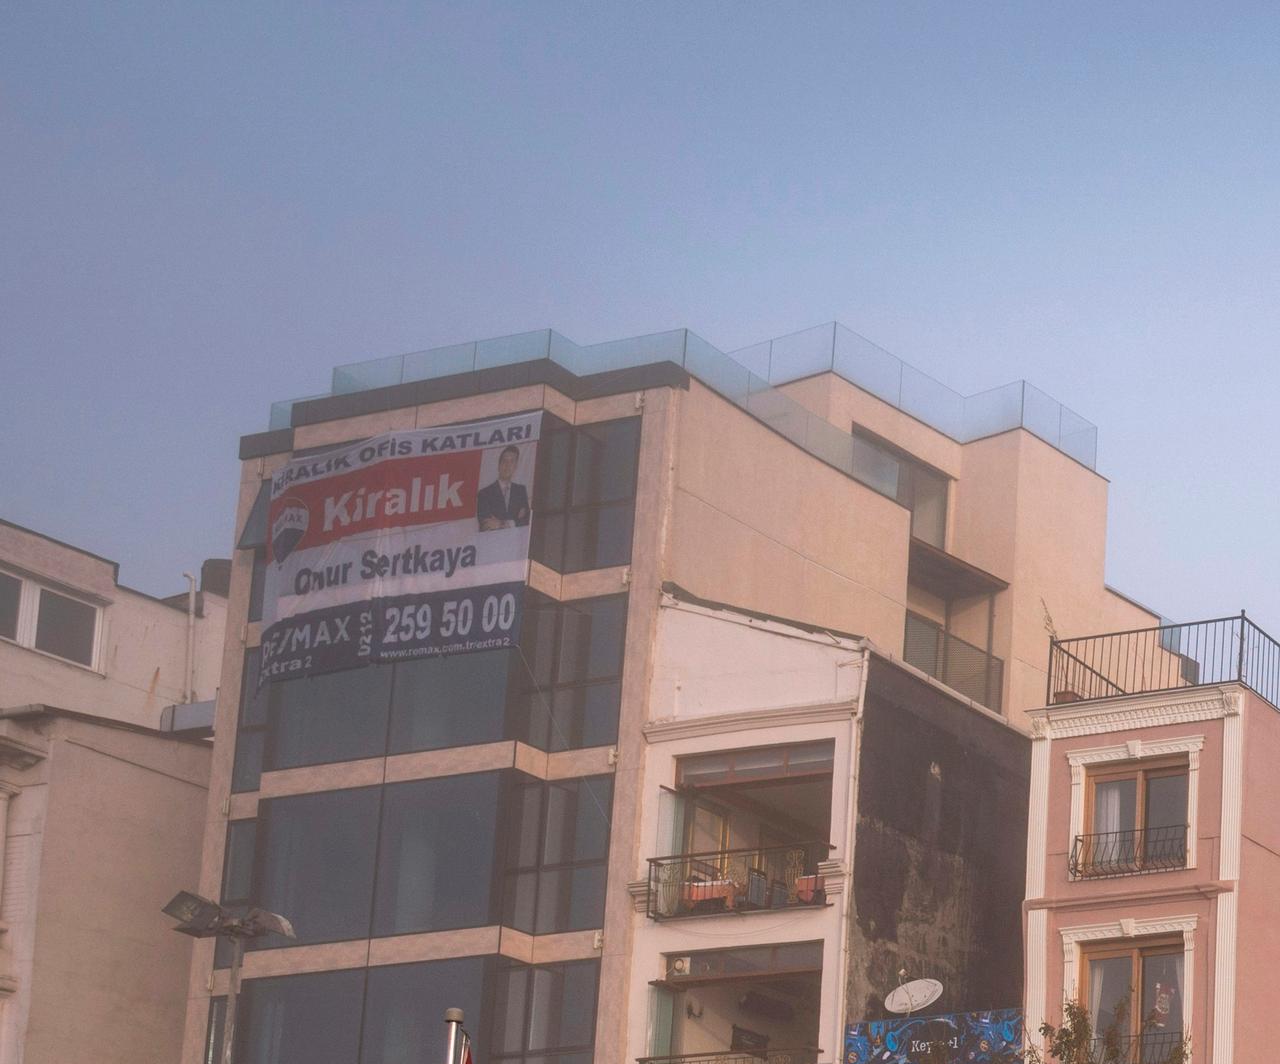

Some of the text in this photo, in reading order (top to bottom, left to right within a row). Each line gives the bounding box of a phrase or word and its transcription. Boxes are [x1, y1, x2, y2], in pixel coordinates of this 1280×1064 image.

[359, 437, 413, 462] OFİS
[421, 423, 532, 454] KATLARI
[323, 473, 464, 532] Kiralık
[294, 544, 477, 596] Onur Sertkaya
[382, 592, 516, 644] 259 50 00
